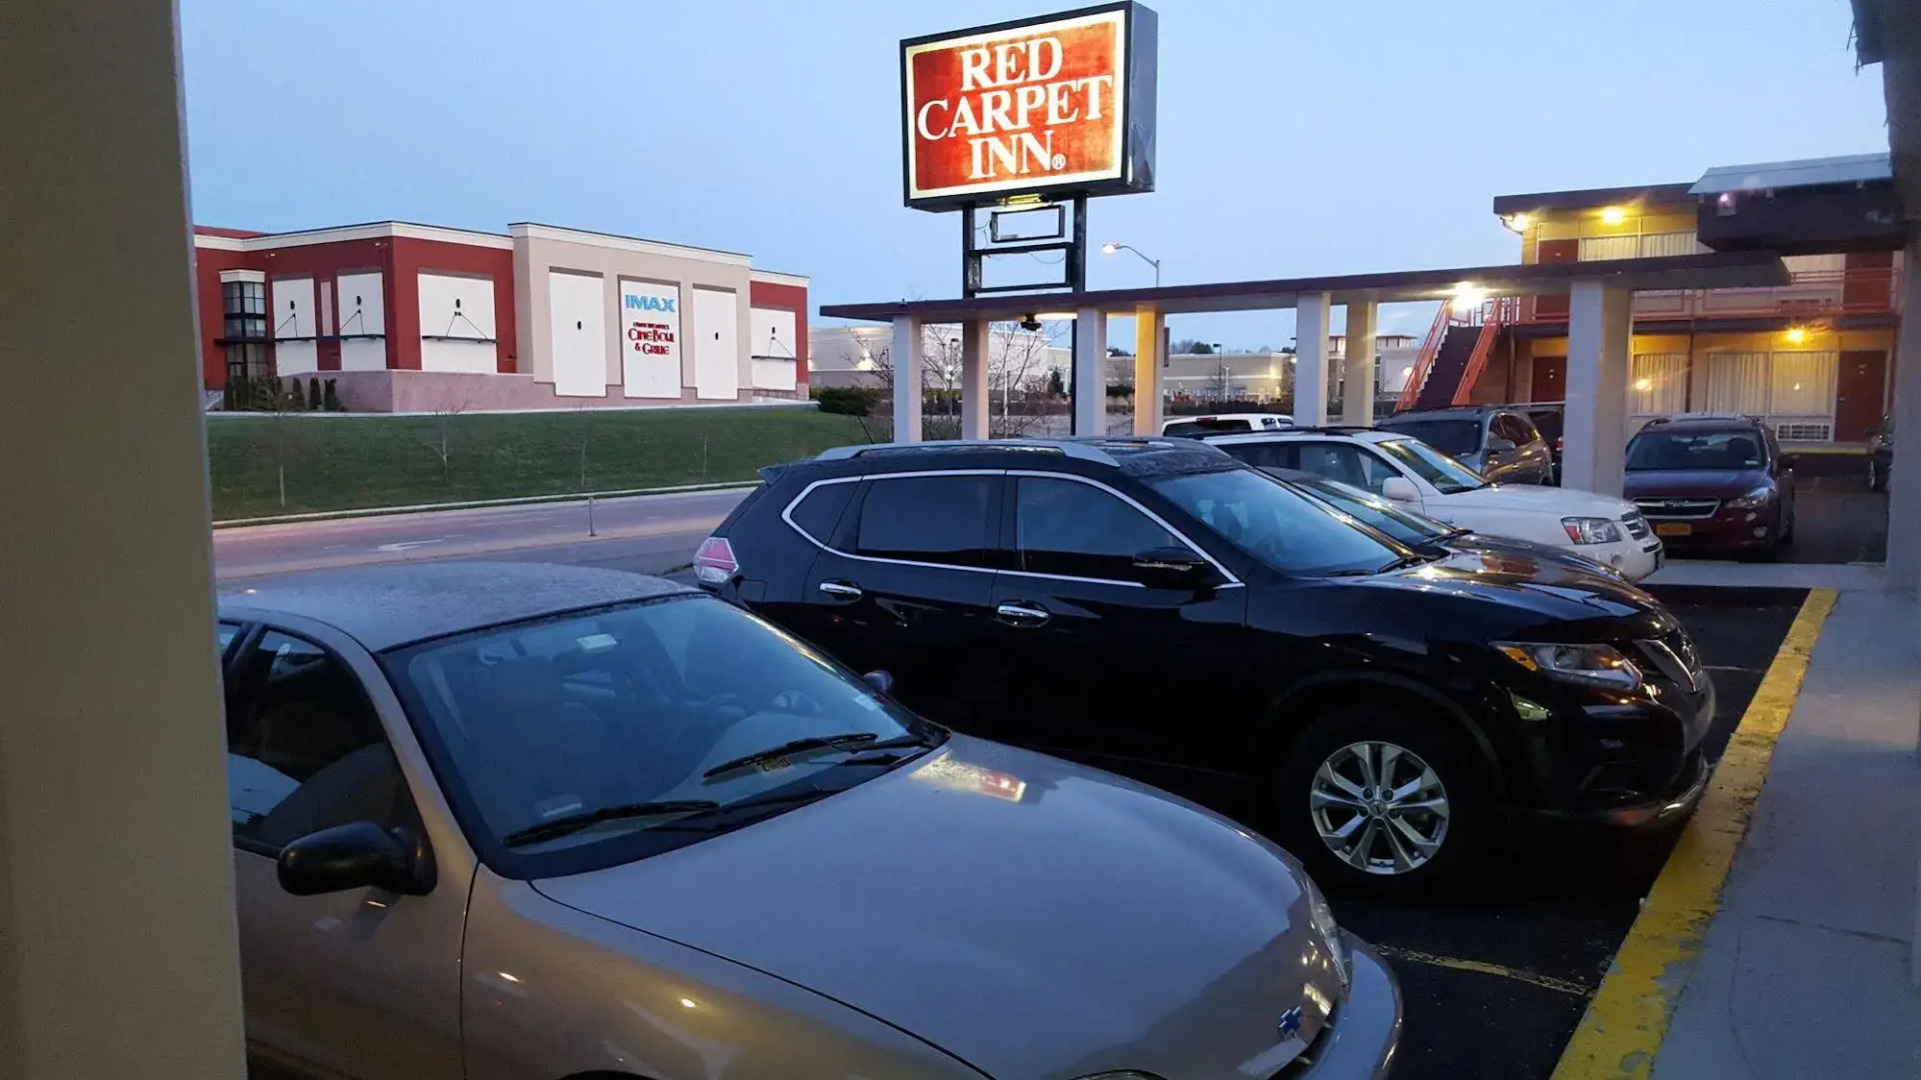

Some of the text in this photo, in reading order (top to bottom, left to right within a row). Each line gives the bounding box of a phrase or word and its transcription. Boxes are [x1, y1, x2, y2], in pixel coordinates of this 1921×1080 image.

[961, 38, 1062, 91] RED
[918, 76, 1112, 140] CARPET
[625, 295, 675, 313] IMAX
[634, 342, 641, 351] &
